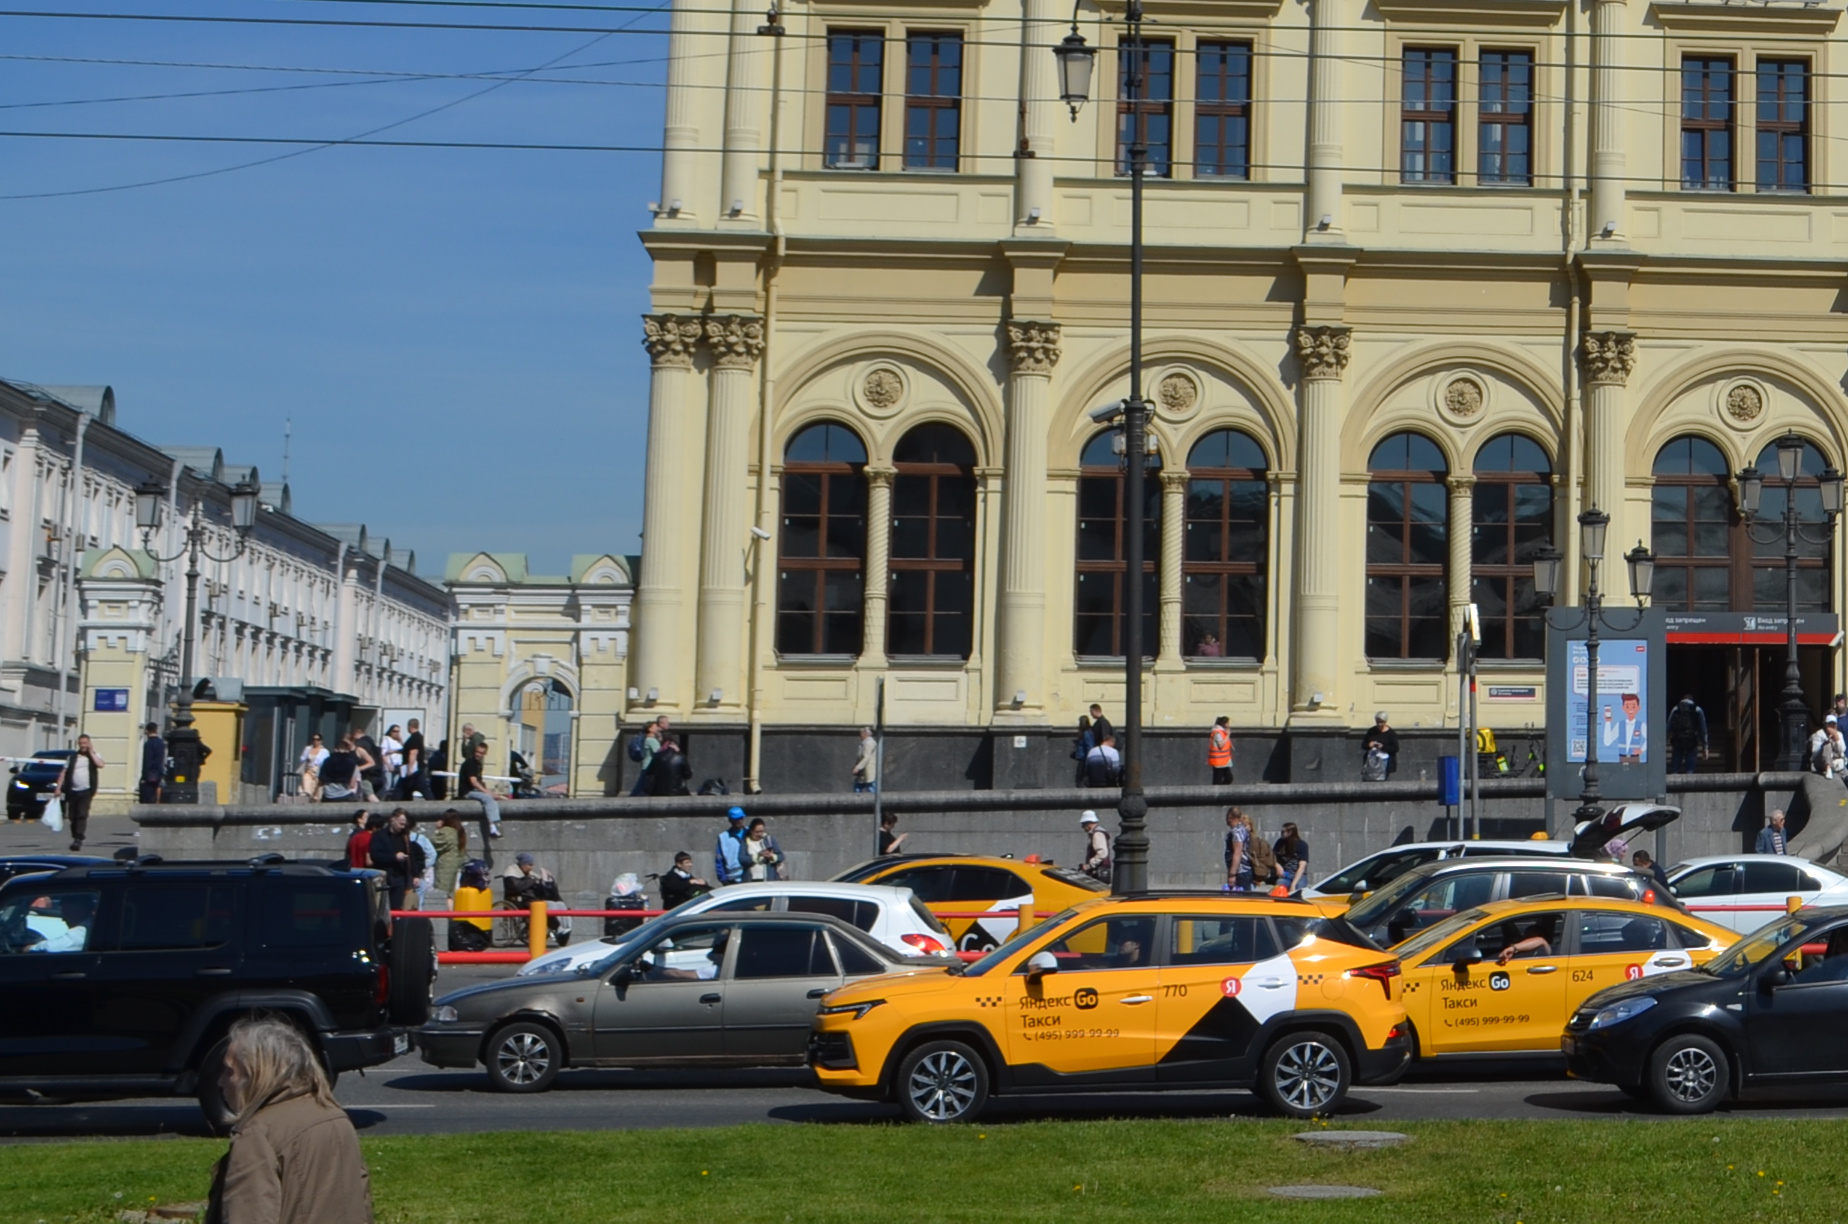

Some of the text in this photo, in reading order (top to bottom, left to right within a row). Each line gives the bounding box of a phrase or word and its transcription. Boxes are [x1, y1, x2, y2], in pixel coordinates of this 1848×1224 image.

[1757, 617, 1773, 625] Вход
[1571, 969, 1594, 982] 624
[1225, 980, 1236, 993] Я
[1441, 975, 1509, 992] Яндекс Go
[1163, 984, 1188, 997] 770
[1019, 990, 1098, 1010] Яндекс Go
[1442, 997, 1477, 1010] Такси
[1020, 1014, 1061, 1028] Такси
[1455, 1014, 1530, 1028] (495) 999-99-99
[1034, 1028, 1120, 1042] (495) 999-99-99
